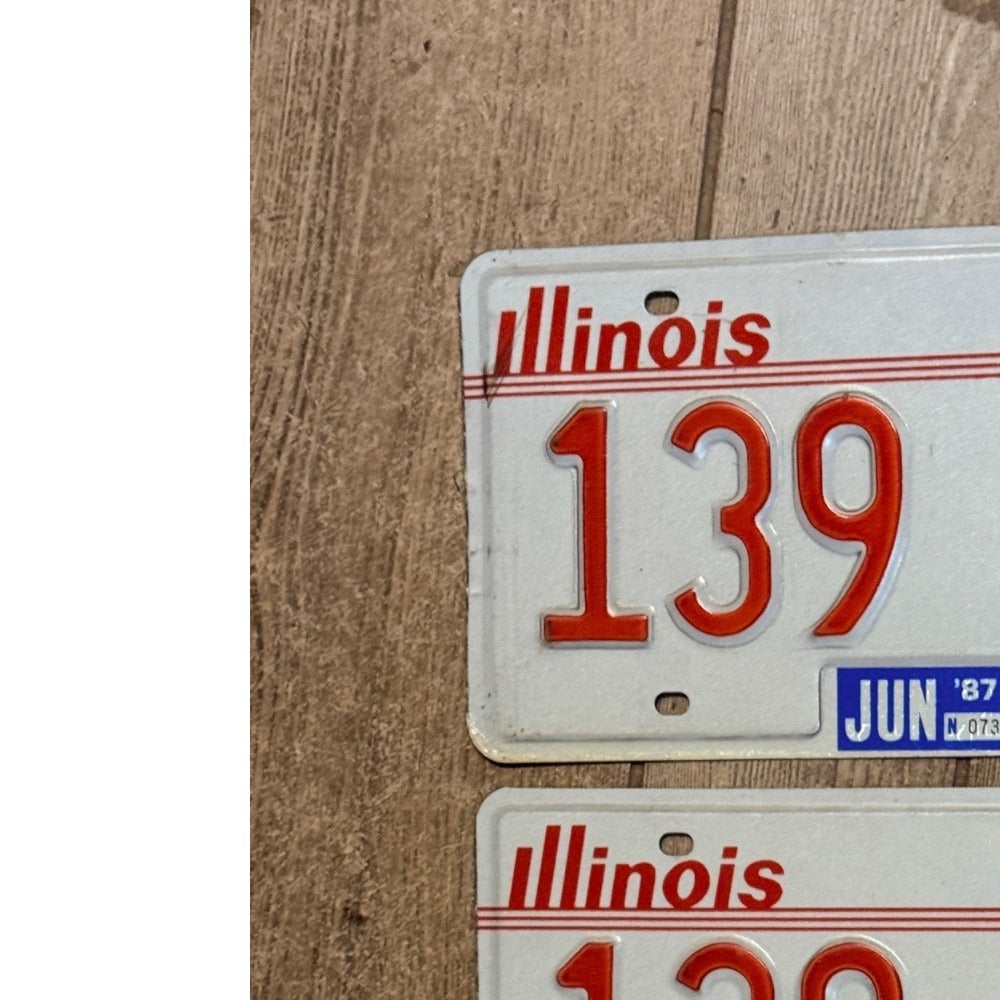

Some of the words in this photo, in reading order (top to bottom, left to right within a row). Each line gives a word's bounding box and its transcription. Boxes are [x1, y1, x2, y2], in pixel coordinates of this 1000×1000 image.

[493, 285, 772, 378] Illinois
[543, 393, 903, 643] 139
[844, 678, 937, 743] JUN
[953, 677, 997, 701] '87
[947, 717, 957, 735] N
[507, 824, 785, 912] Illinois
